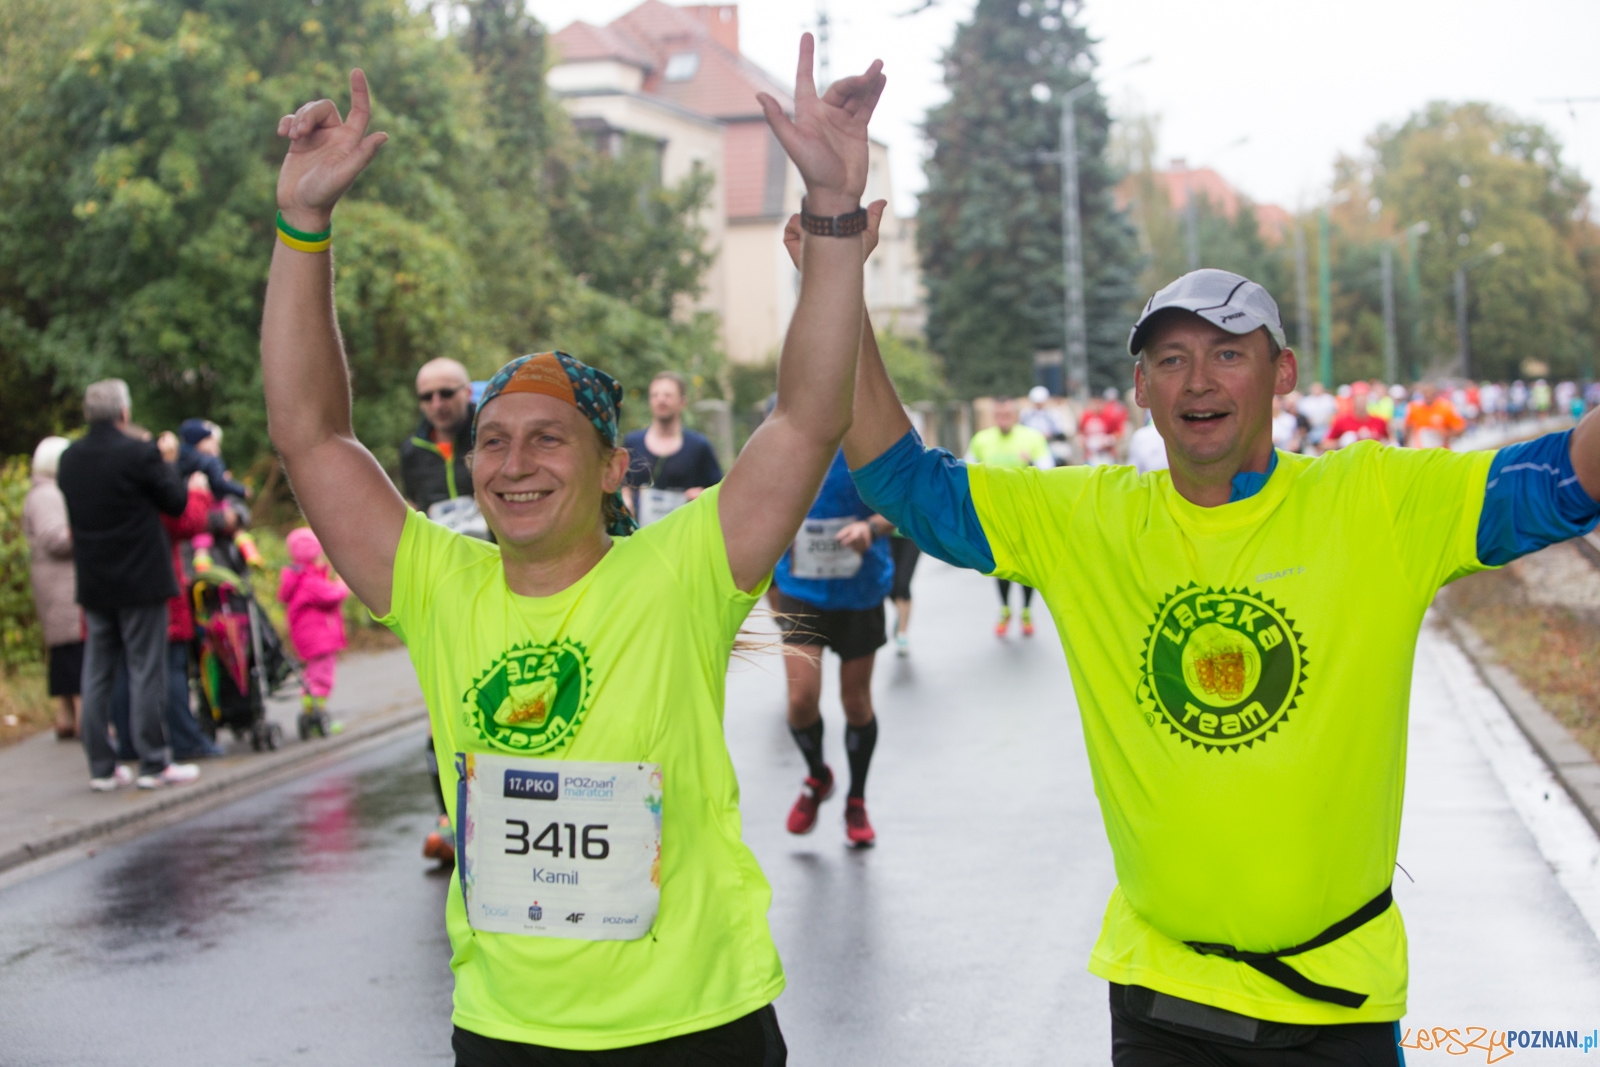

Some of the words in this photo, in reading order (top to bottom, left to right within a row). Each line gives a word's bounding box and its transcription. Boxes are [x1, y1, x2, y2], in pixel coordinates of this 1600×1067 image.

[1256, 567, 1295, 583] CRAFT
[564, 787, 614, 798] maraton
[504, 818, 610, 860] 3416
[533, 867, 579, 886] Kamil
[565, 912, 586, 924] 4F
